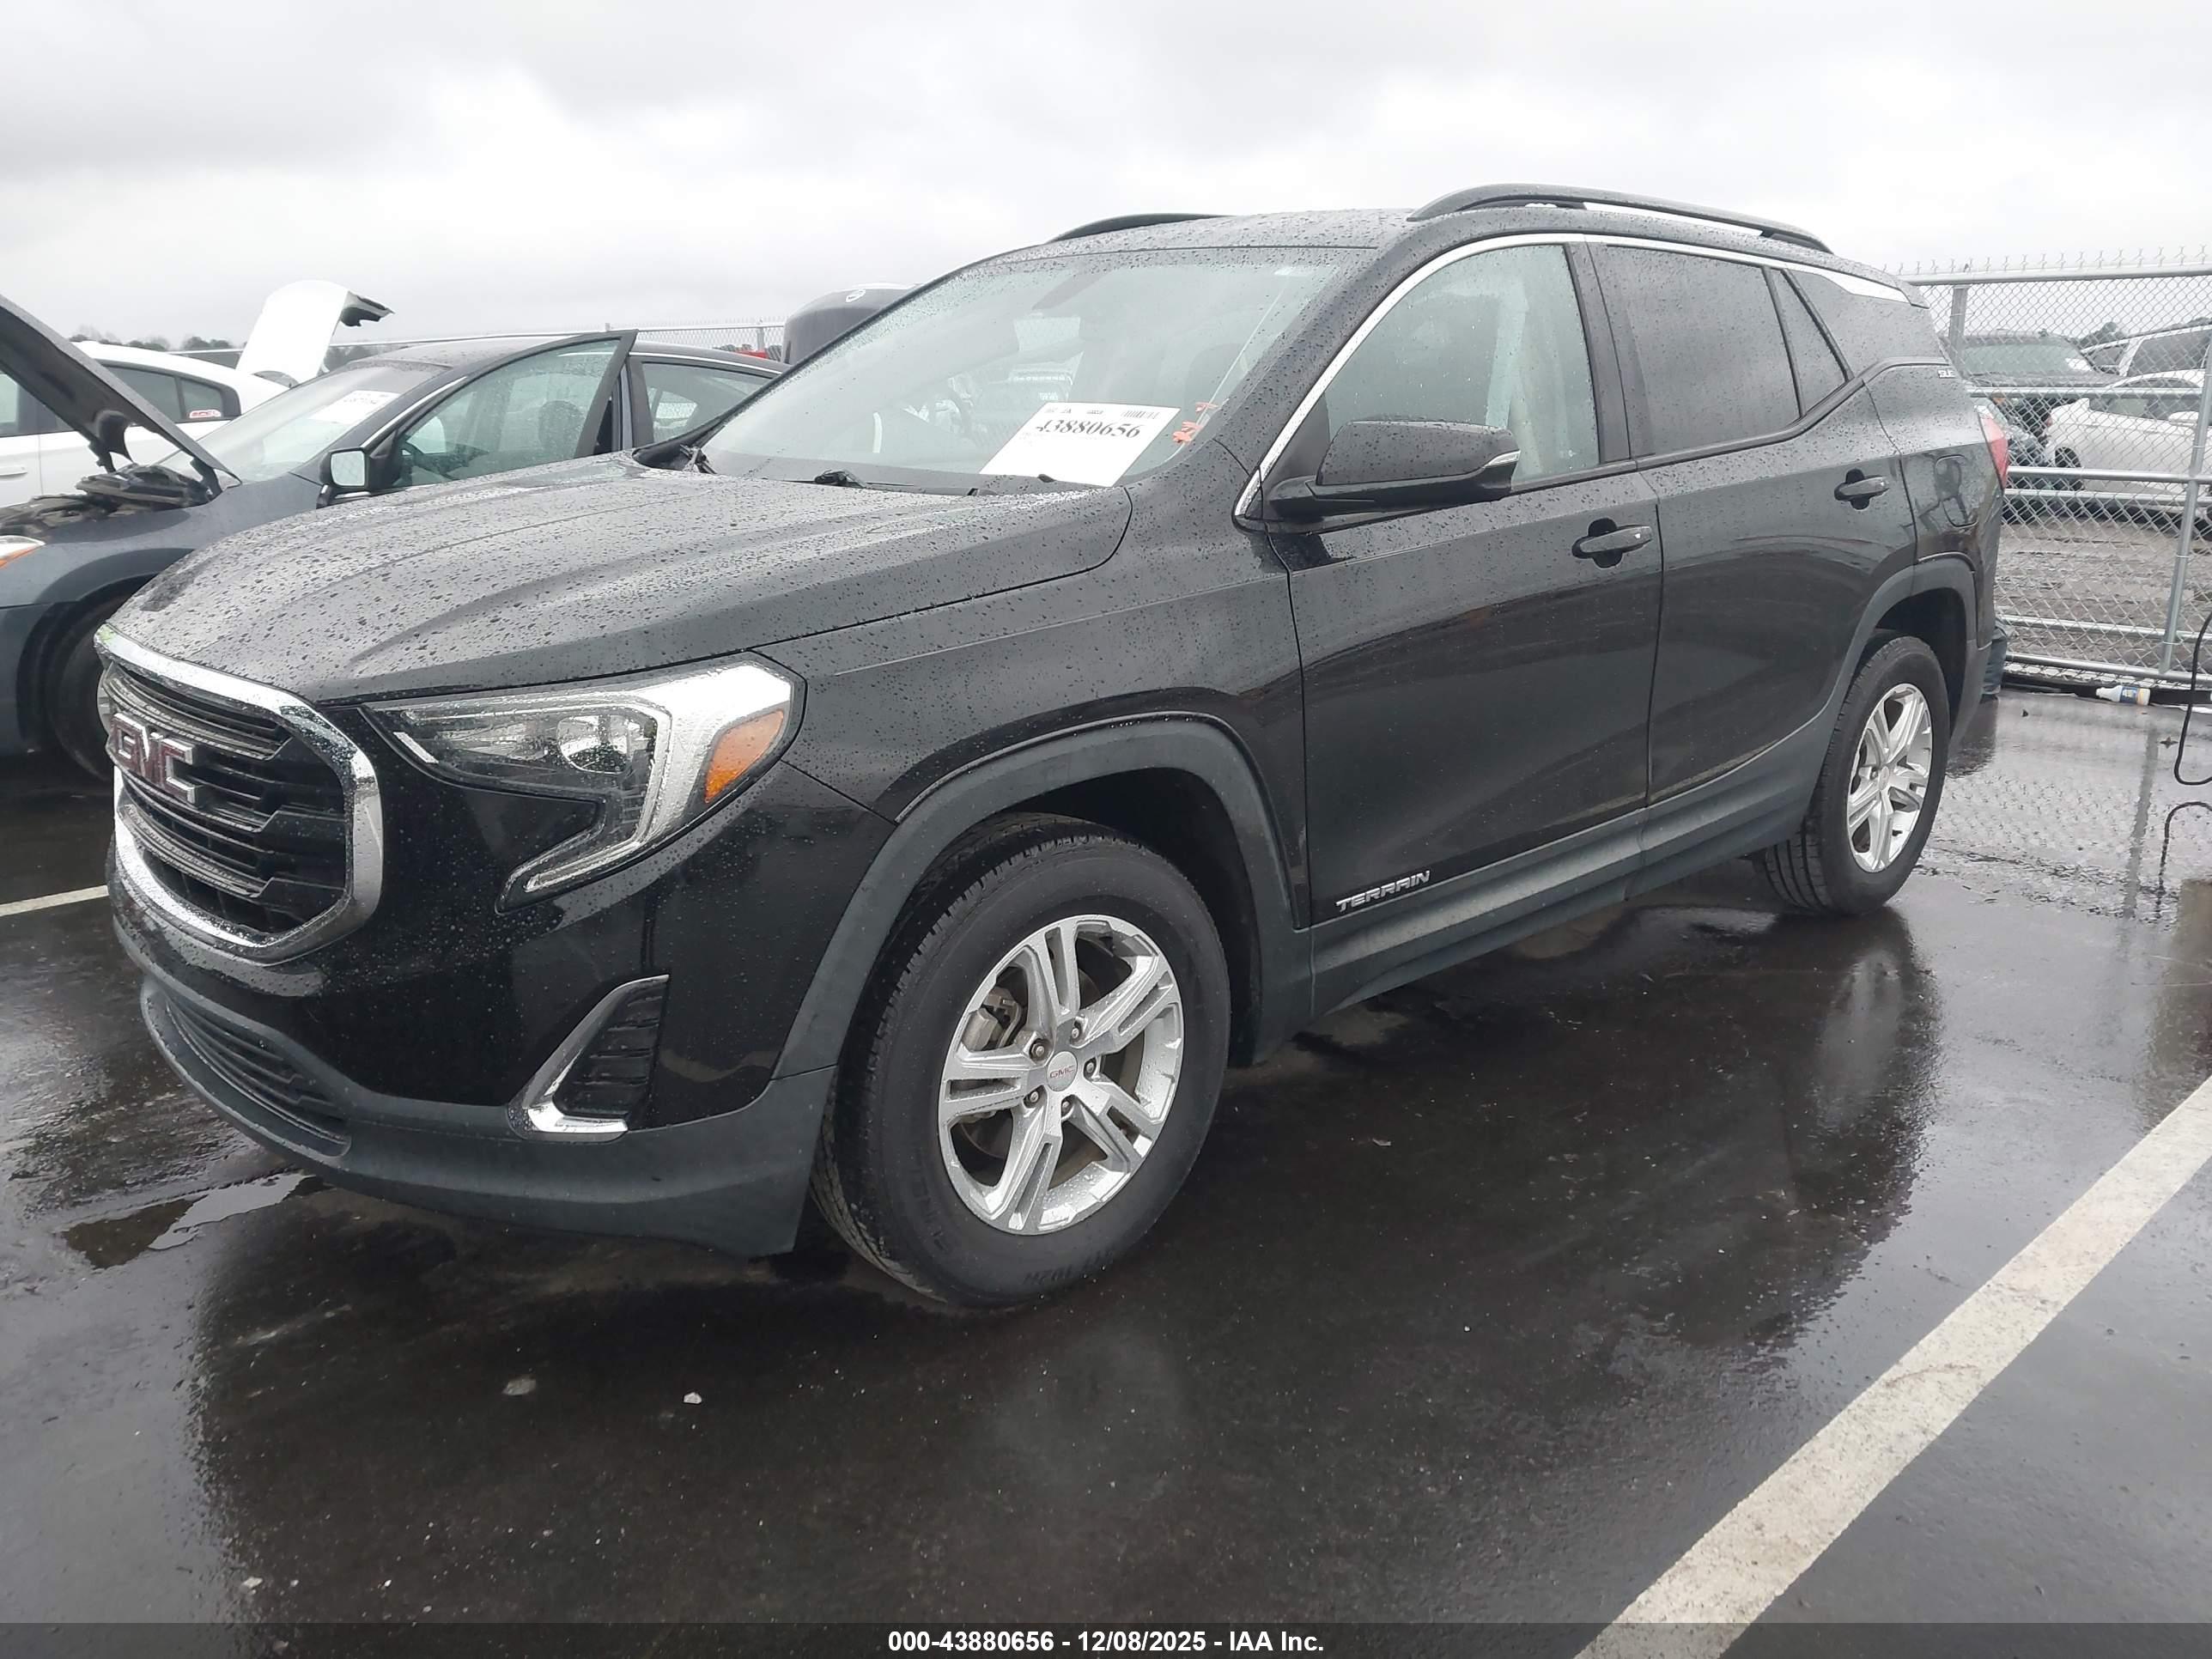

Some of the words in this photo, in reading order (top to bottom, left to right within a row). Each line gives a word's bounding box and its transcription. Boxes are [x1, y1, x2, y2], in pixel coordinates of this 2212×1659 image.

[1036, 419, 1144, 438] 43880656
[108, 713, 196, 805] GMC
[1335, 870, 1431, 913] TERRAIN
[1049, 1065, 1074, 1079] GMC
